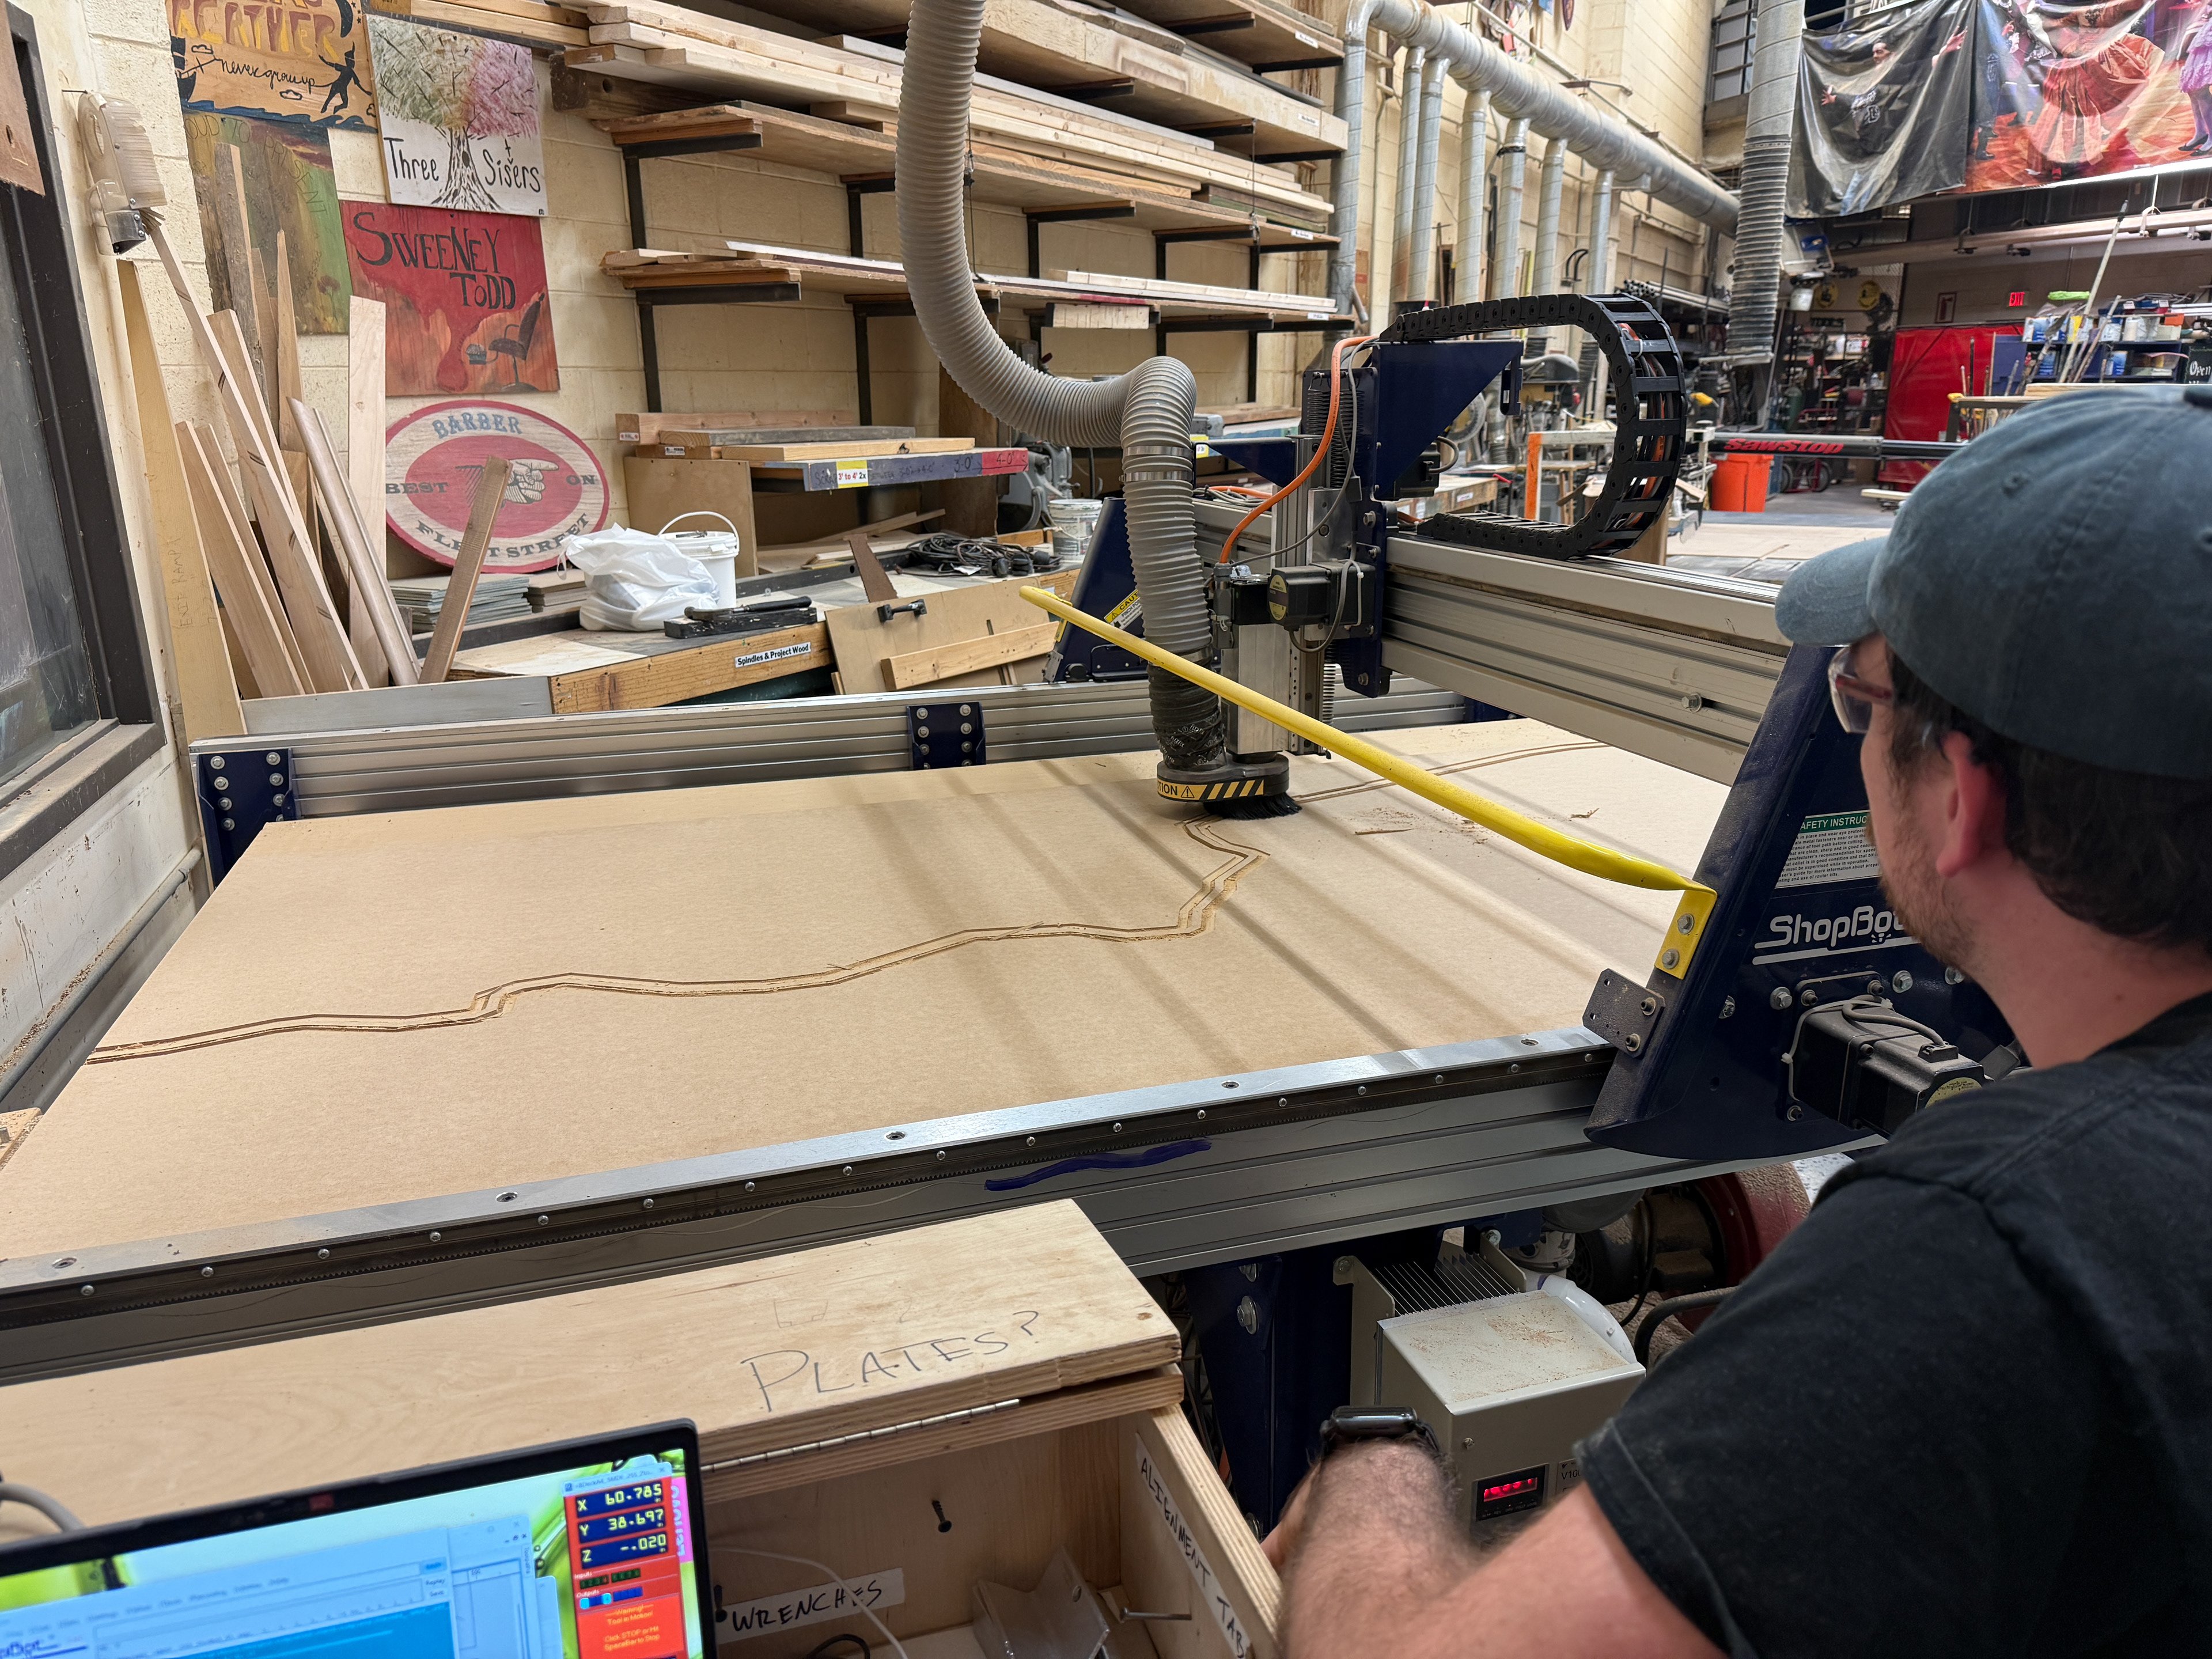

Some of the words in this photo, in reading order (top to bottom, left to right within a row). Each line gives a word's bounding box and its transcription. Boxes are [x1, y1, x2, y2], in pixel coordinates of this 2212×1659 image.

[226, 117, 251, 143] TO
[384, 137, 439, 181] Three
[353, 212, 501, 274] SWEENEY
[2009, 292, 2025, 307] EXIT
[2190, 361, 2211, 376] Open
[432, 412, 523, 440] BARBER
[1724, 438, 1844, 454] SawStop
[838, 472, 843, 480] 3'
[385, 481, 449, 495] BEST
[566, 474, 596, 486] ON
[737, 654, 764, 666] Spindles
[764, 652, 770, 660] &
[770, 647, 791, 659] Project
[792, 643, 809, 654] Wood
[1157, 781, 1178, 796] TION
[577, 1499, 588, 1512] X
[605, 1483, 662, 1506] 60.785
[579, 1524, 589, 1536] Y
[608, 1509, 664, 1531] 38.697
[1141, 1457, 1210, 1588] ALIGNMENT
[582, 1549, 592, 1562] Z
[574, 1571, 593, 1580] Inputs
[577, 1589, 600, 1599] Outputs
[733, 1580, 882, 1631] WRENCHES
[607, 1618, 623, 1626] Tool
[630, 1611, 653, 1620] Motion!
[605, 1634, 621, 1642] Click
[621, 1628, 642, 1639] STOP
[645, 1634, 660, 1642] Stop
